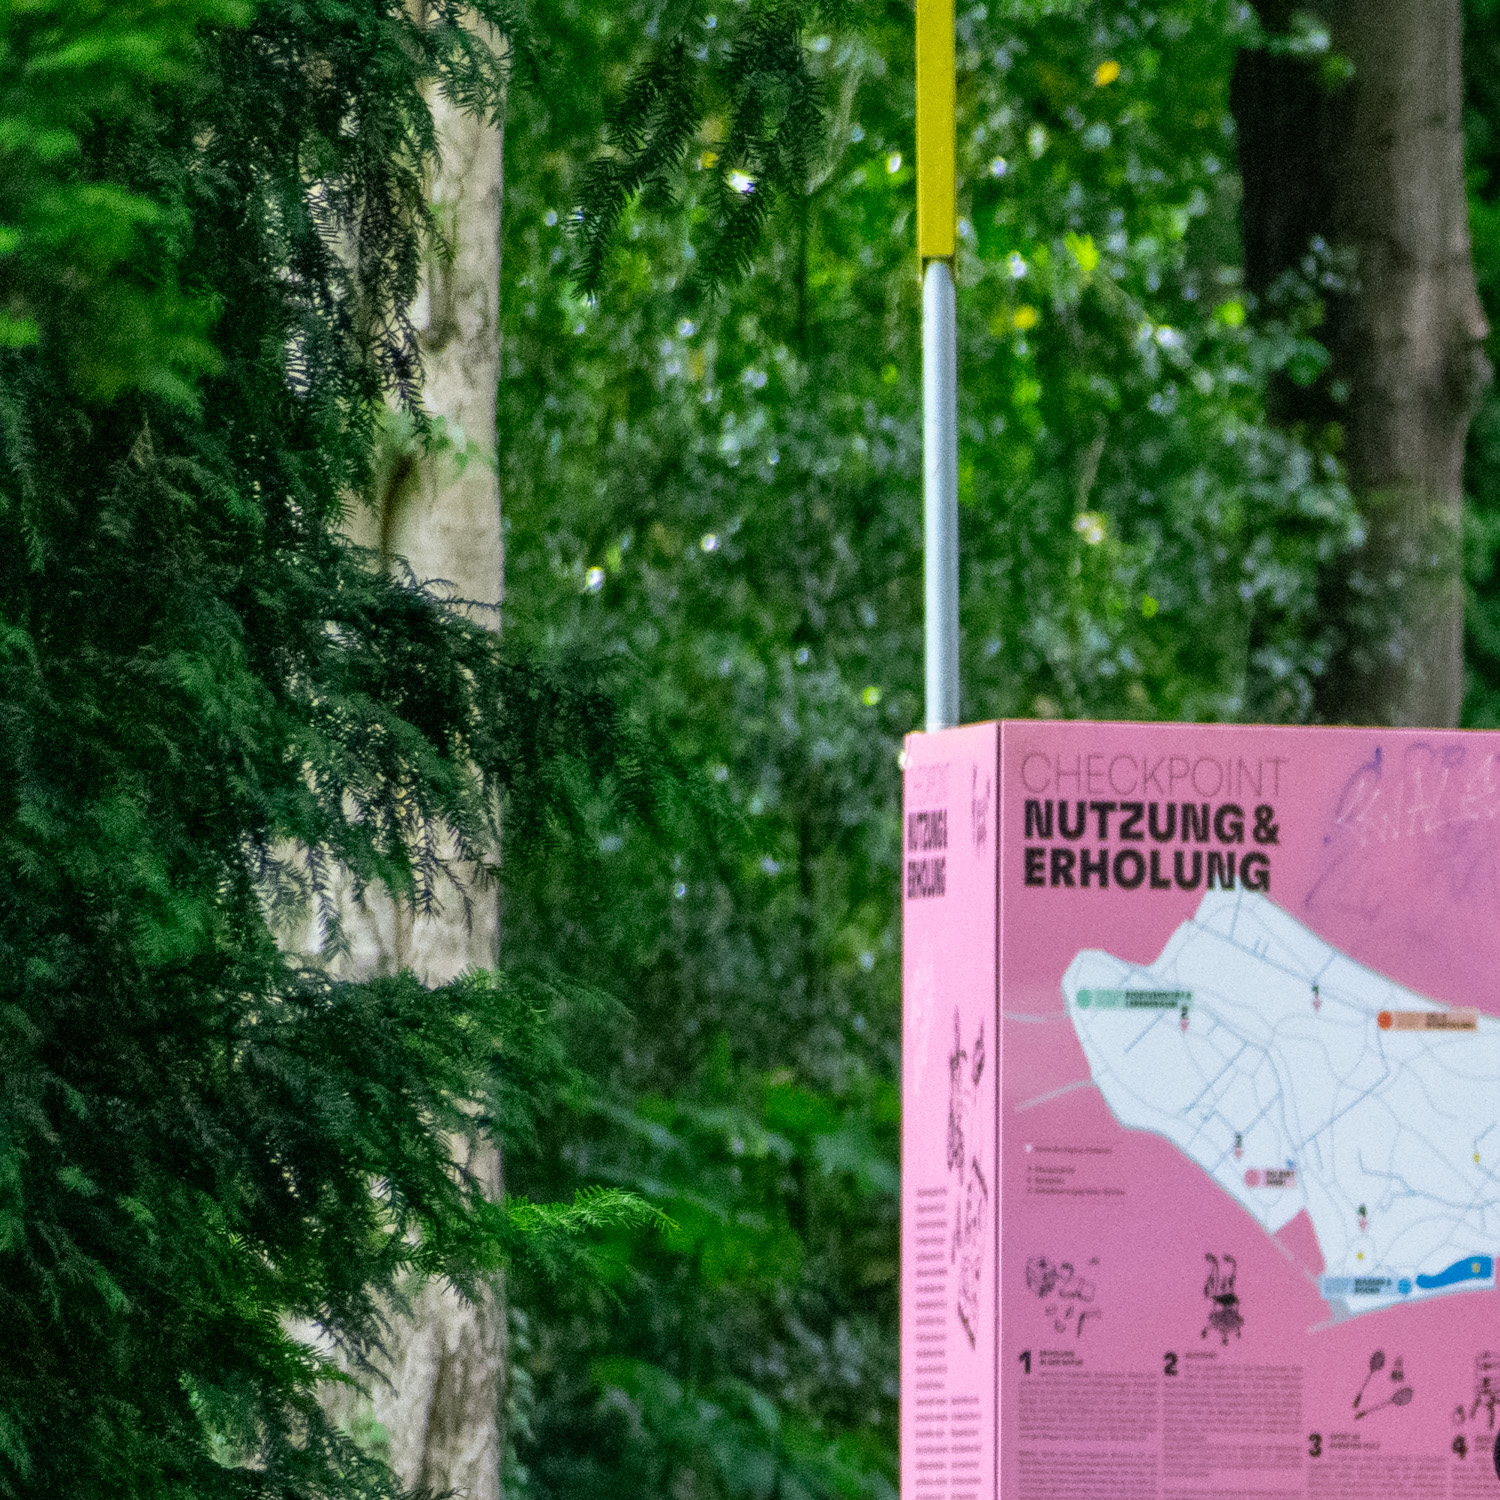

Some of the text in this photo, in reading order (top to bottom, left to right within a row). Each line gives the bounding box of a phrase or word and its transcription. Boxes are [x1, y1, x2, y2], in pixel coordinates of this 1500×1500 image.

[1021, 752, 1289, 798] CHECKPOINT
[1024, 848, 1270, 892] ERHOLUNG
[1019, 1349, 1032, 1375] 1
[1164, 1351, 1179, 1377] 2
[1309, 1432, 1323, 1458] 3
[1452, 1434, 1468, 1461] 4
